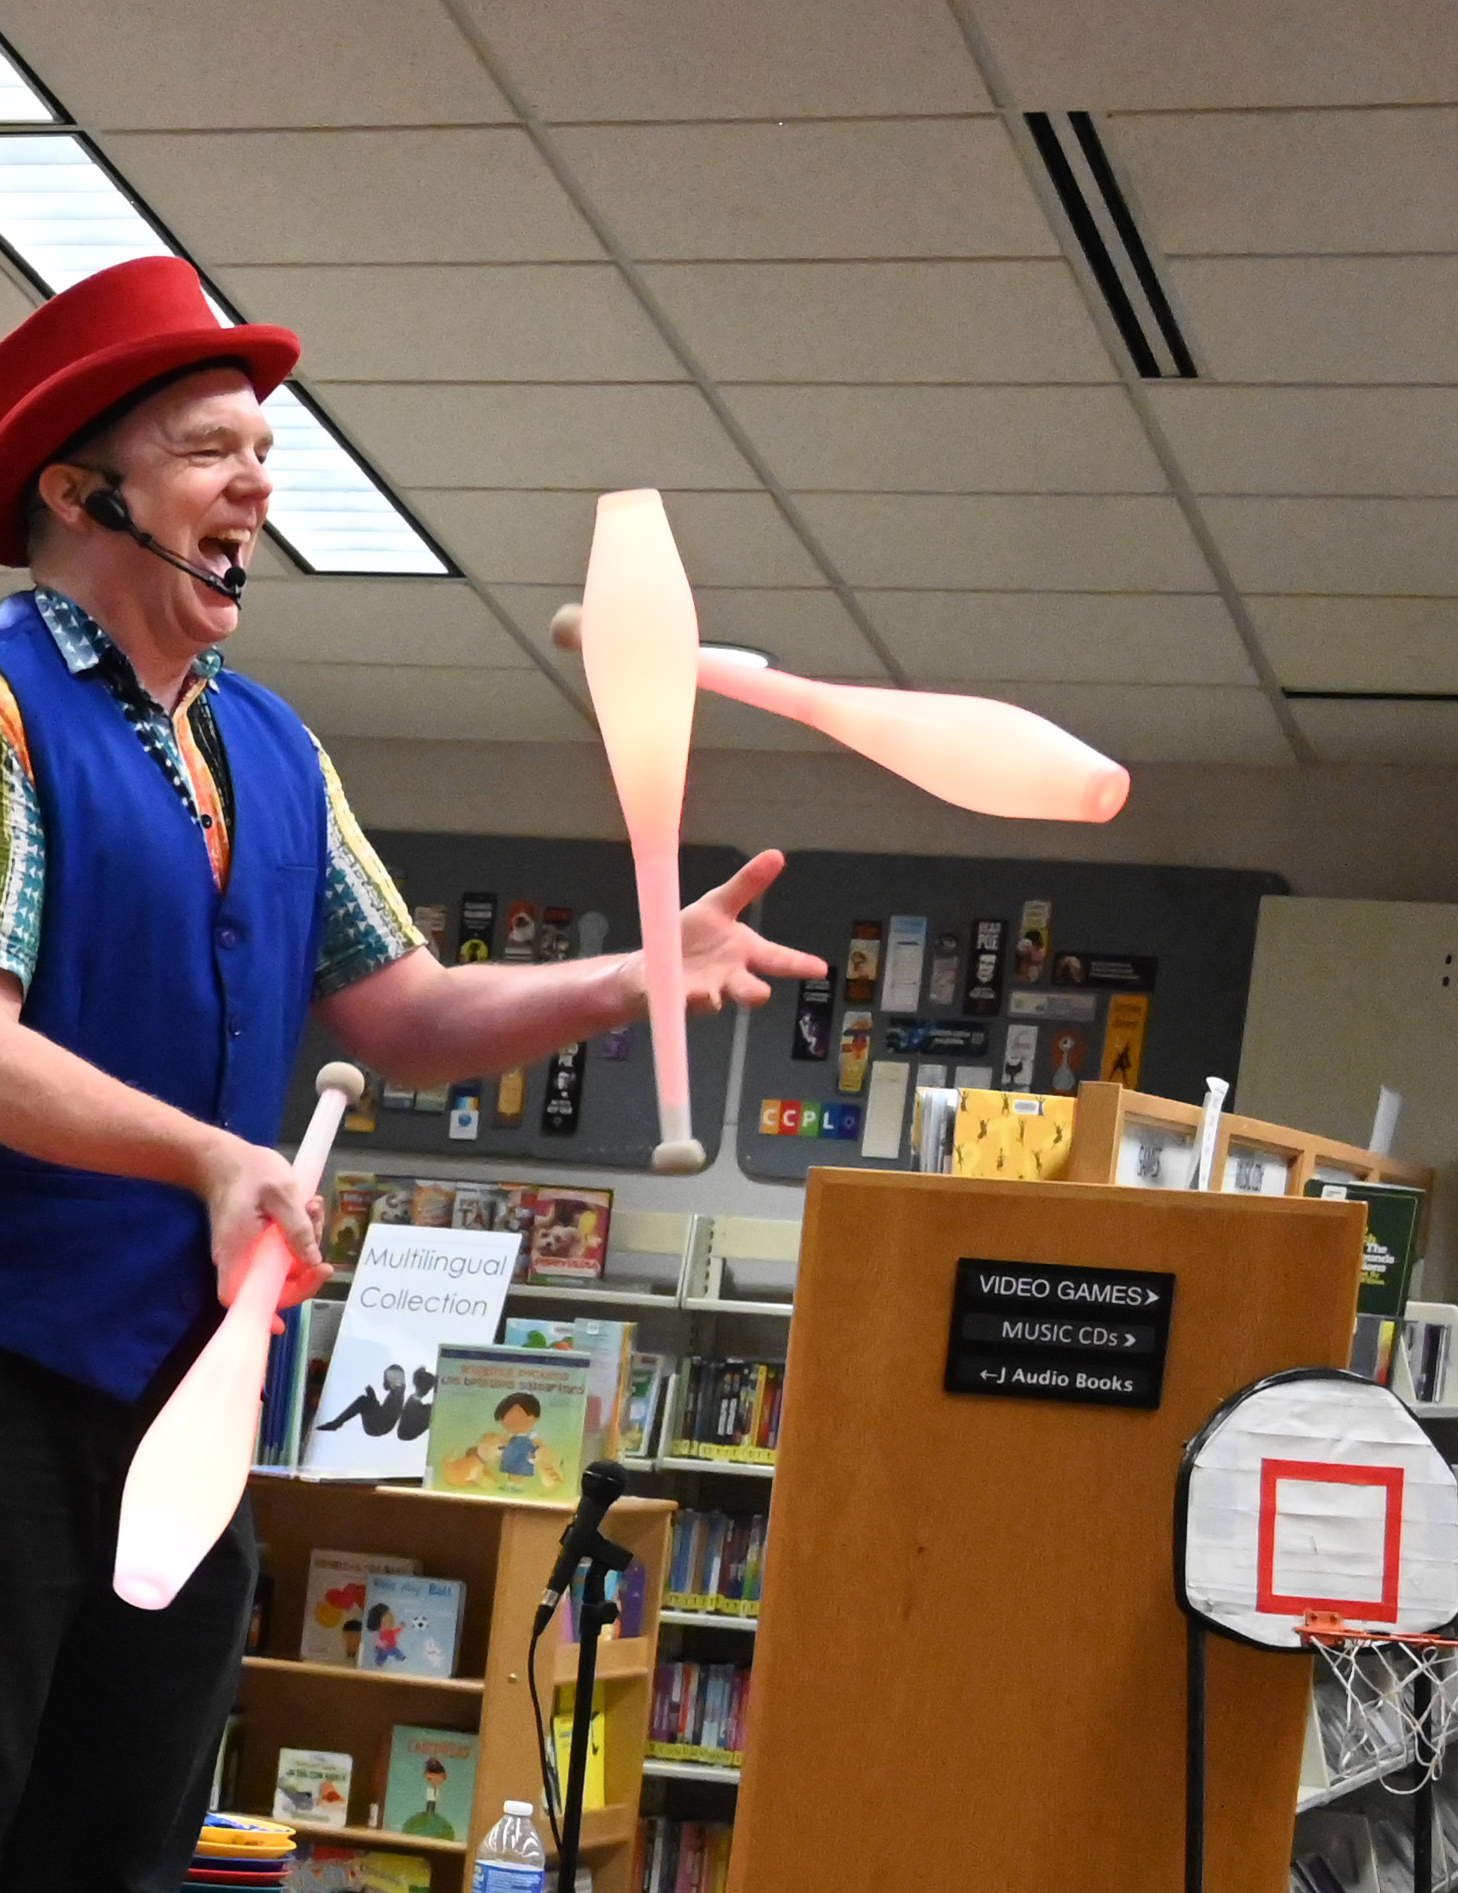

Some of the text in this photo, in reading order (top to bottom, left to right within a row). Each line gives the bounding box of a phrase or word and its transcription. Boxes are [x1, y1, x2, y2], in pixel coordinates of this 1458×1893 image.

[762, 1108, 834, 1130] CCPL
[363, 1247, 510, 1280] Multilingual
[360, 1286, 488, 1317] Collection
[979, 1274, 1143, 1306] VIDEO GAMES
[1002, 1321, 1118, 1347] MUSIC CDs
[996, 1366, 1134, 1392] J Audio Books
